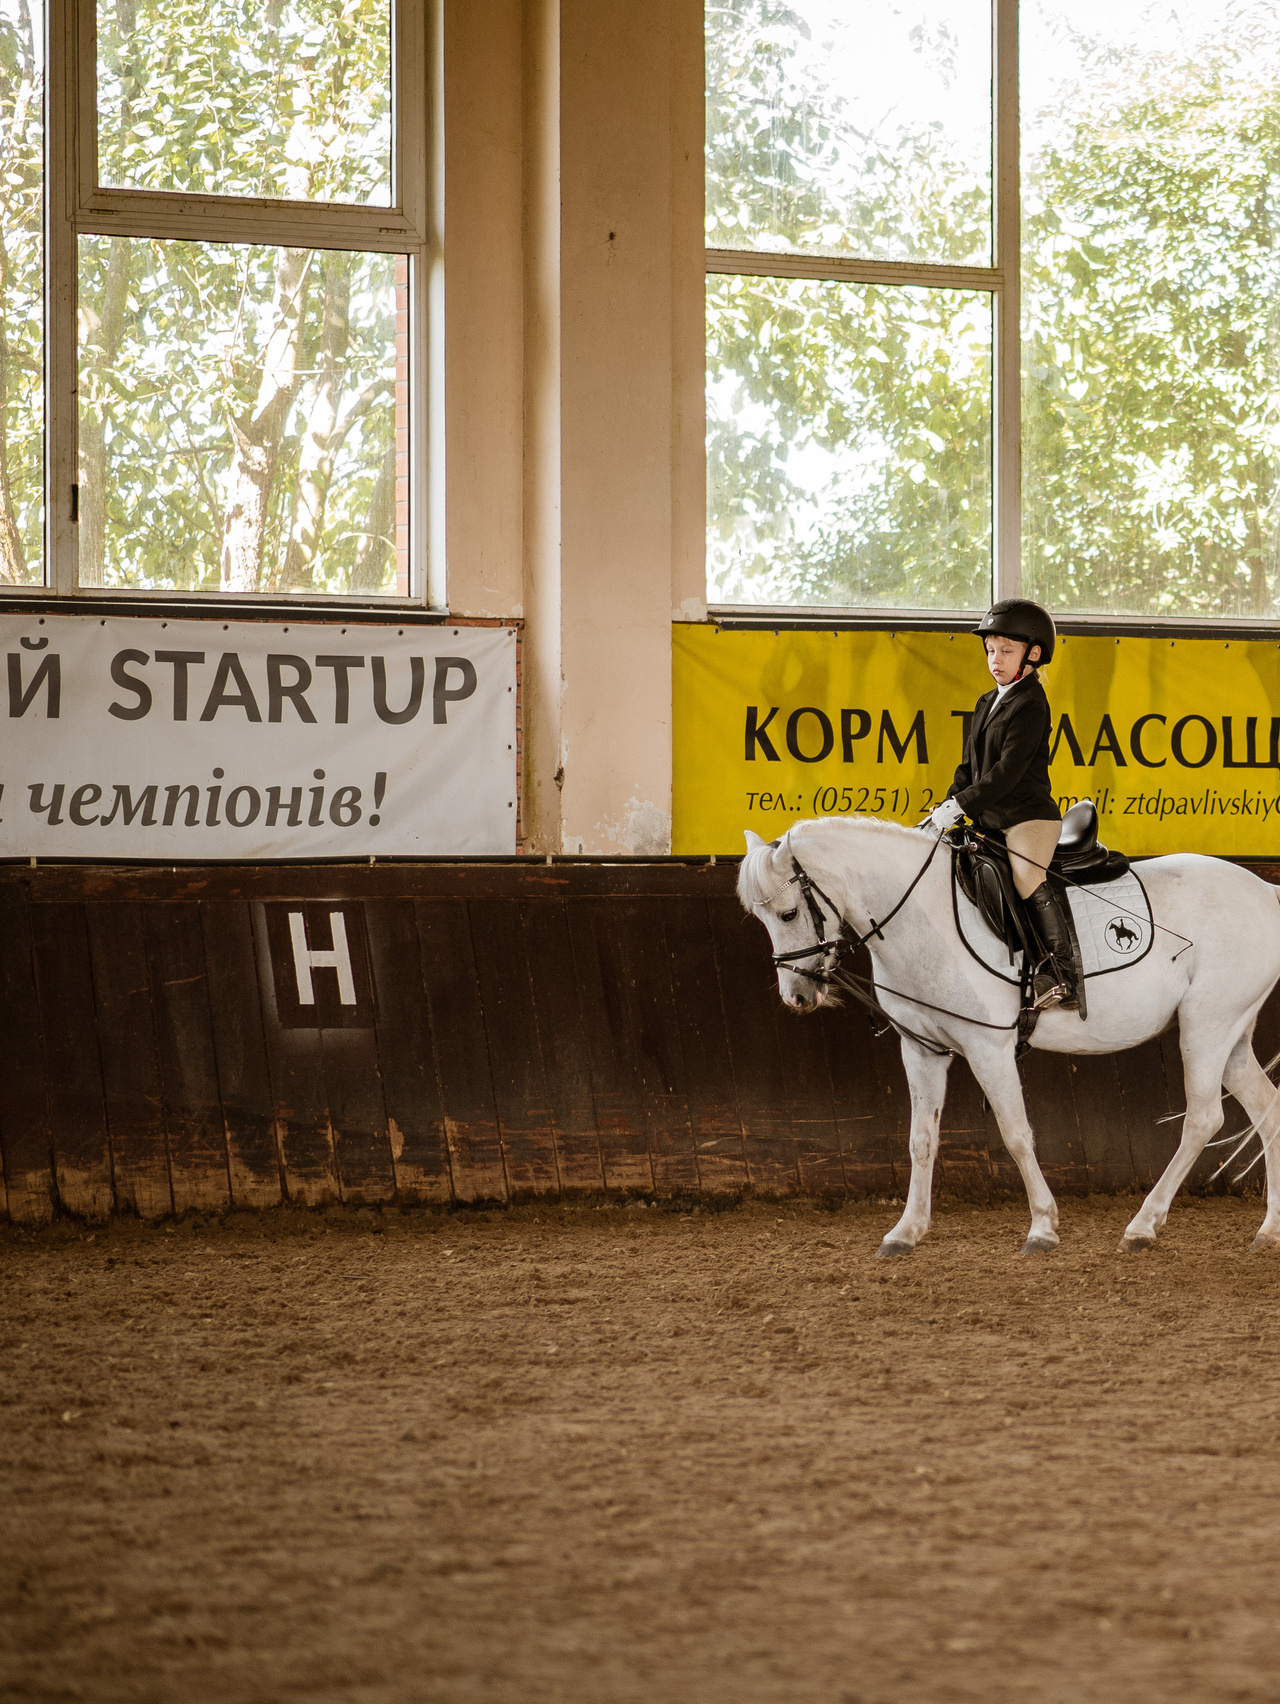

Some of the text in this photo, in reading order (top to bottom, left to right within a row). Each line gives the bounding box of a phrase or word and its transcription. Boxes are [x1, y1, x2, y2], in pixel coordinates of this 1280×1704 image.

[107, 648, 478, 725] STARTUP
[745, 705, 929, 765] КОРМ
[27, 767, 388, 828] чемпіонів!
[746, 792, 803, 812] тел.:
[813, 785, 910, 816] (05251)
